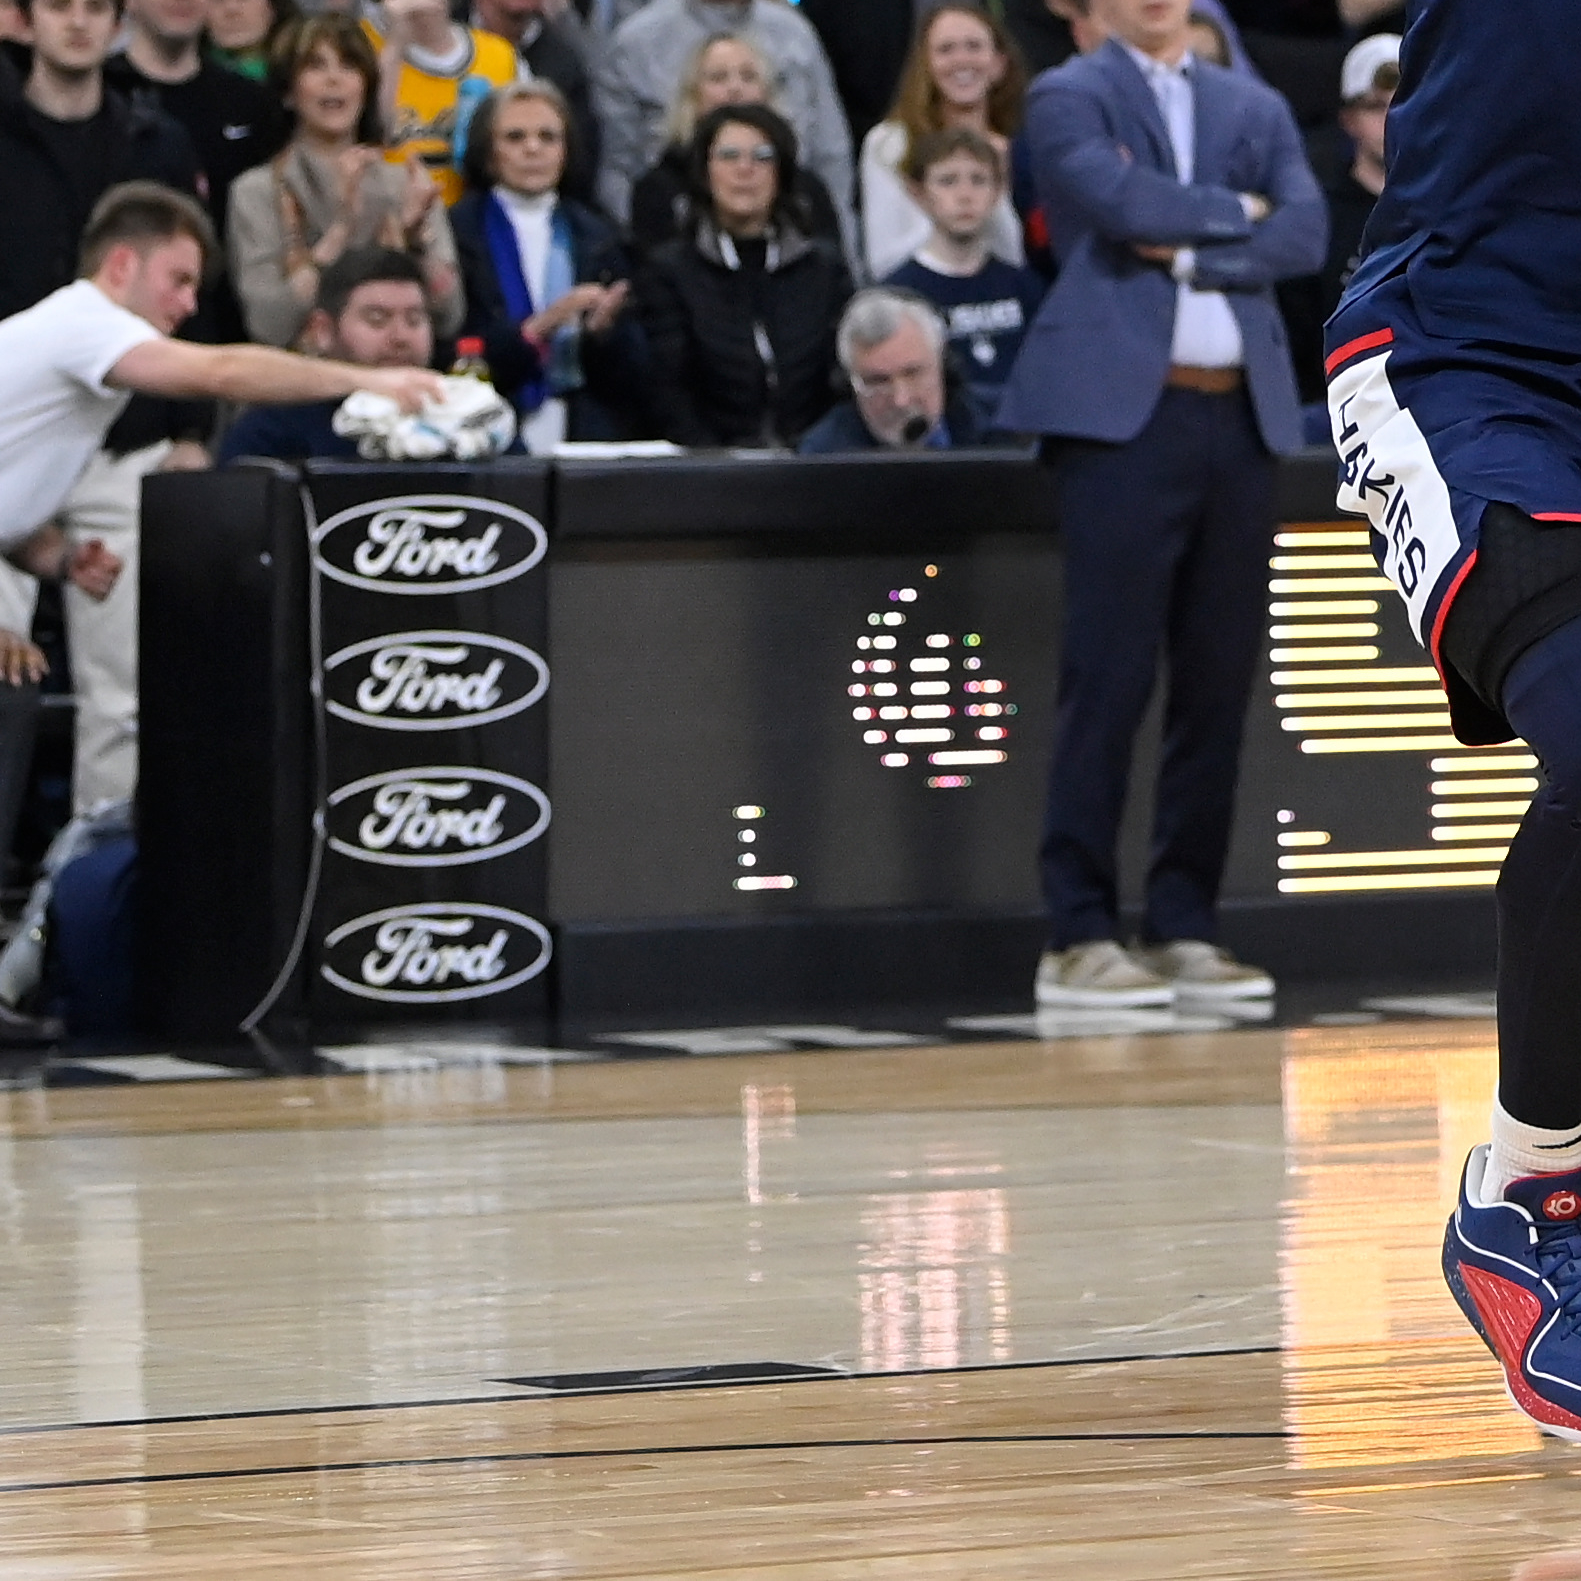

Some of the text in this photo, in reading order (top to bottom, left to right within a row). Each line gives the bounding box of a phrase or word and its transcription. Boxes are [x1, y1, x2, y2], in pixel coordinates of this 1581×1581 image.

[353, 508, 504, 577] Ford
[356, 645, 505, 713] Ford
[359, 780, 507, 850] Ford
[361, 917, 511, 986] Ford
